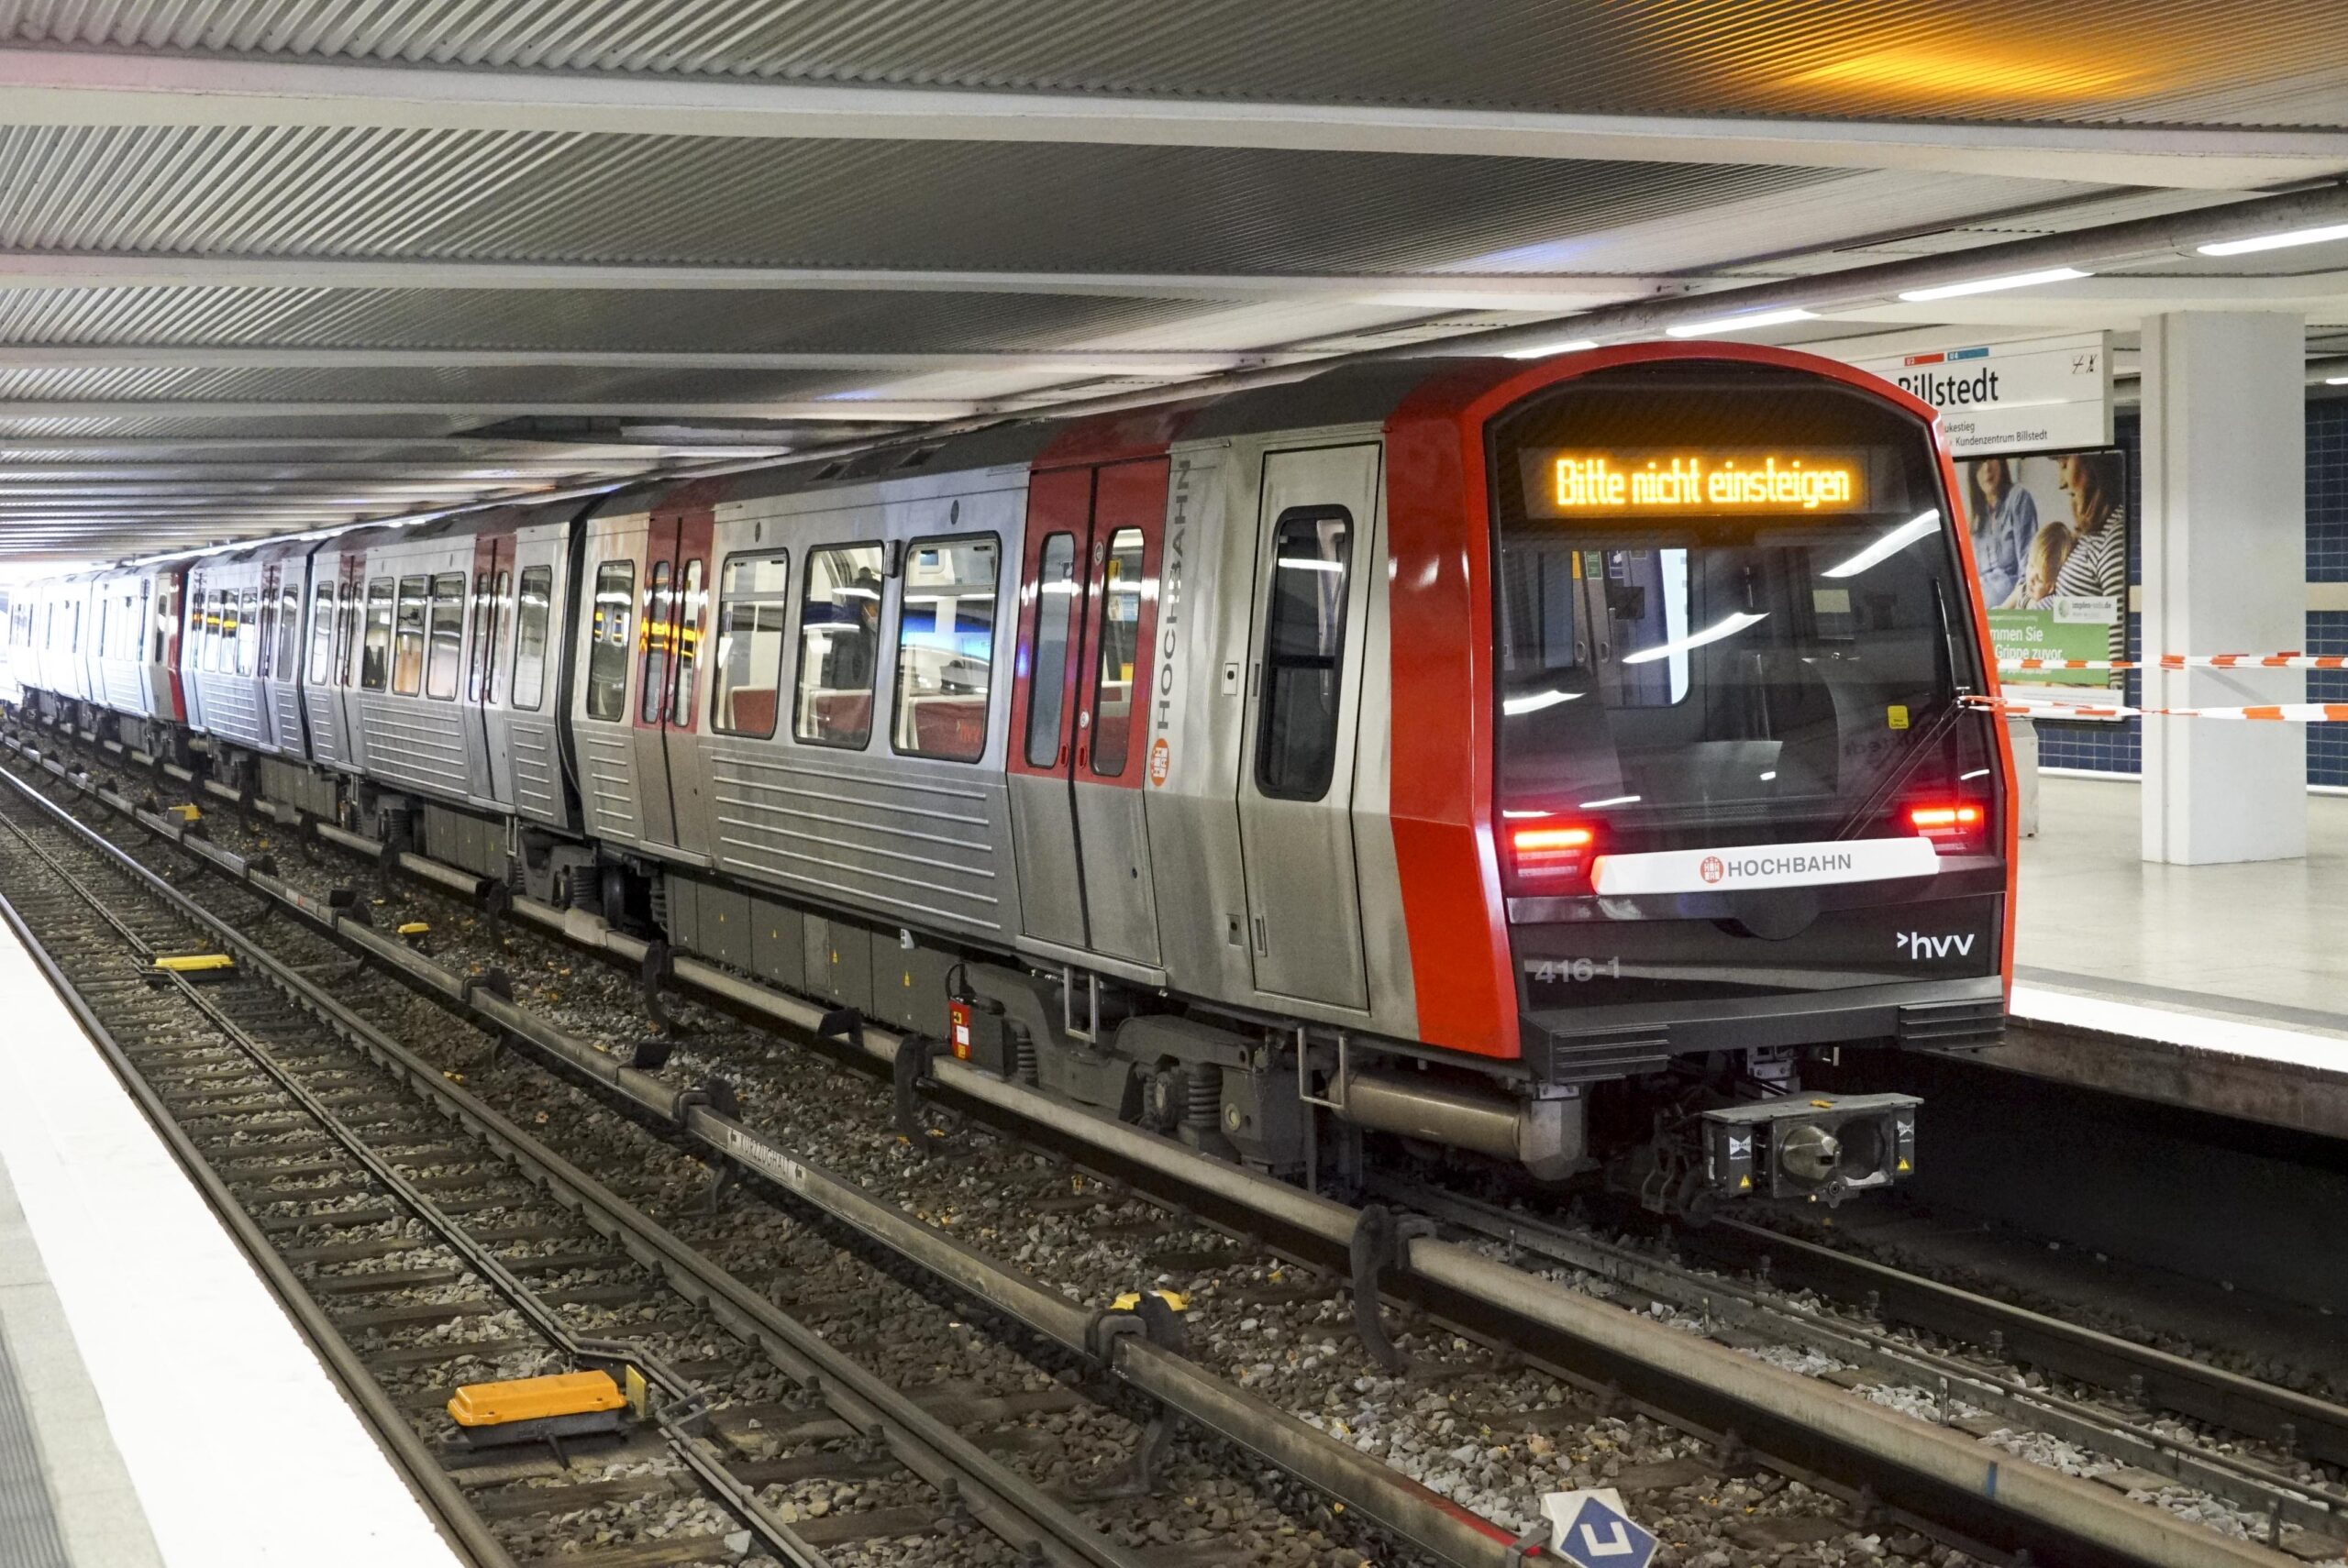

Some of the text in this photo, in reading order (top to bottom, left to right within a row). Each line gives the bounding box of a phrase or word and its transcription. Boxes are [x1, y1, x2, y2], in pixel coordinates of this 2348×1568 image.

[1944, 421, 1976, 434] ukestieg
[1955, 429, 2048, 447] Kundenzentrum Billstedt
[1557, 458, 1850, 508] Bitte nicht einsteigen
[1157, 460, 1191, 730] HOCHBAHN
[1990, 626, 2043, 642] mmen Sie
[1996, 645, 2029, 660] Grippe
[1728, 854, 1852, 877] HOCHBAHN
[1534, 955, 1620, 983] 416-1
